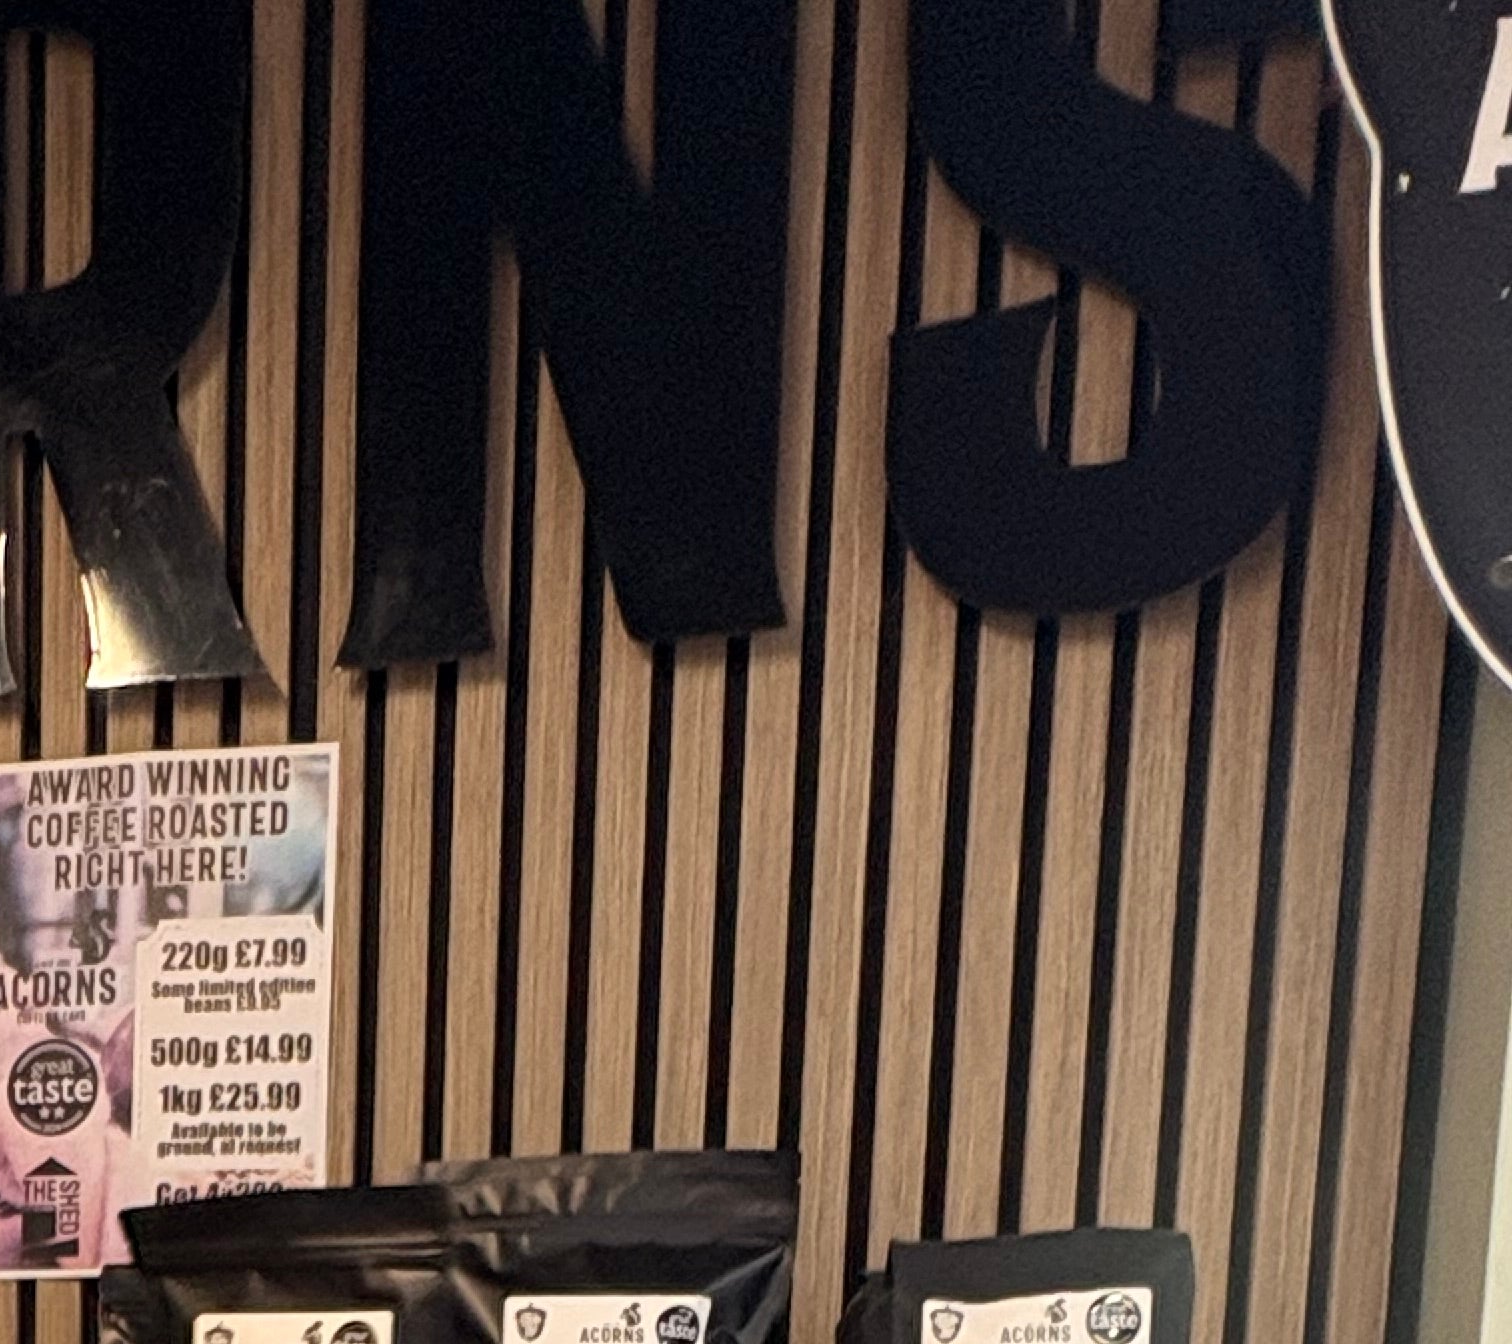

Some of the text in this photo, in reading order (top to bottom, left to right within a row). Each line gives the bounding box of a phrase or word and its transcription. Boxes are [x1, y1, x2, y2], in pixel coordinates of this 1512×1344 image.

[28, 756, 292, 807] AWARD WINNING
[28, 800, 288, 848] COFFEE ROASTED
[54, 846, 248, 890] RIGHT HERE!
[161, 937, 306, 972] 220g £7.99
[151, 977, 316, 998] Some limited edition
[150, 1033, 313, 1068] 500g £14.99
[30, 1059, 74, 1080] great
[13, 1078, 94, 1105] taste
[159, 1082, 301, 1115] 1kg £25.99
[23, 1180, 56, 1201] THE
[59, 1180, 80, 1235] SHED
[579, 1327, 644, 1343] ACORNS
[1000, 1325, 1071, 1344] ACORNS
